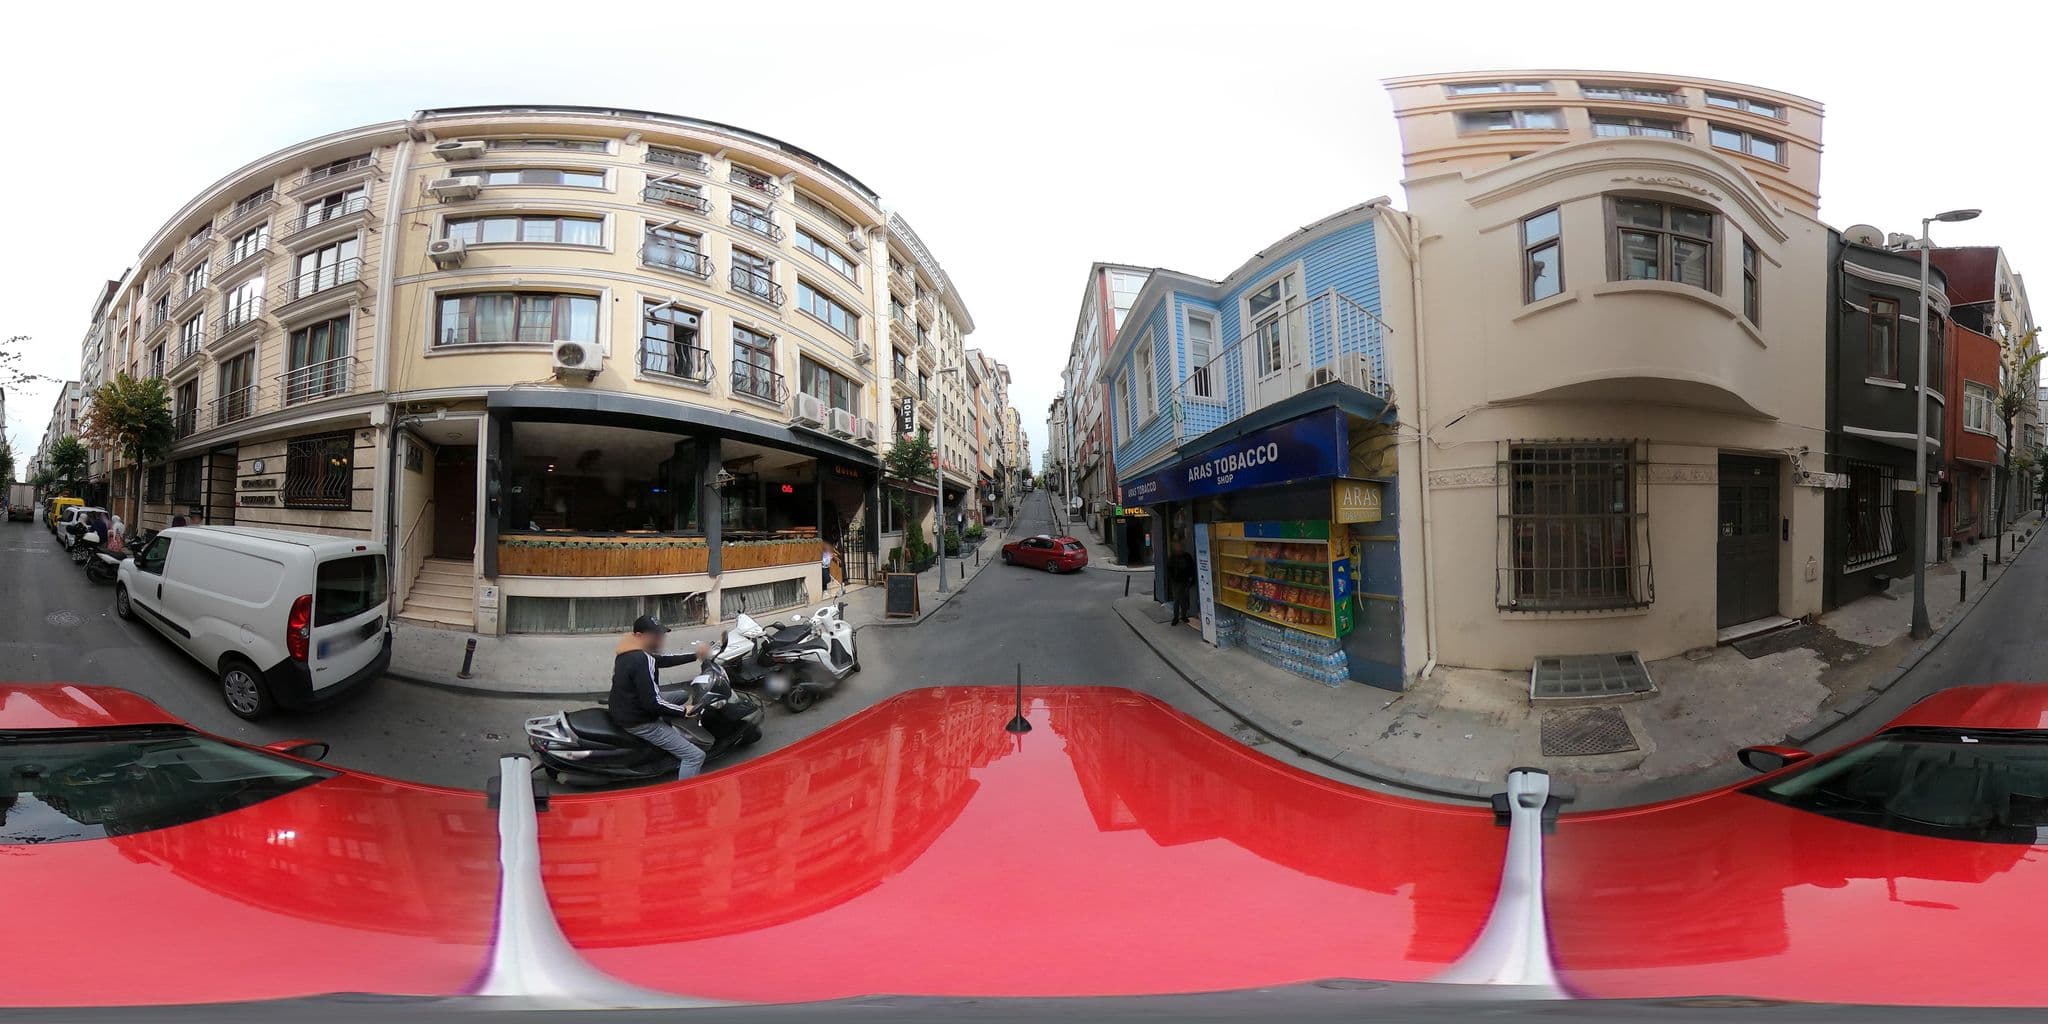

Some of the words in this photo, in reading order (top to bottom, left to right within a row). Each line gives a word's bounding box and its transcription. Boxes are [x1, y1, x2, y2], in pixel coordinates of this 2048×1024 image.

[903, 398, 912, 430] HOTEL
[1188, 462, 1212, 482] ARAS
[1214, 442, 1279, 476] TOBACCO
[1137, 480, 1157, 496] TOBACCO
[1217, 473, 1234, 485] SHOP
[1343, 487, 1379, 506] ARAS
